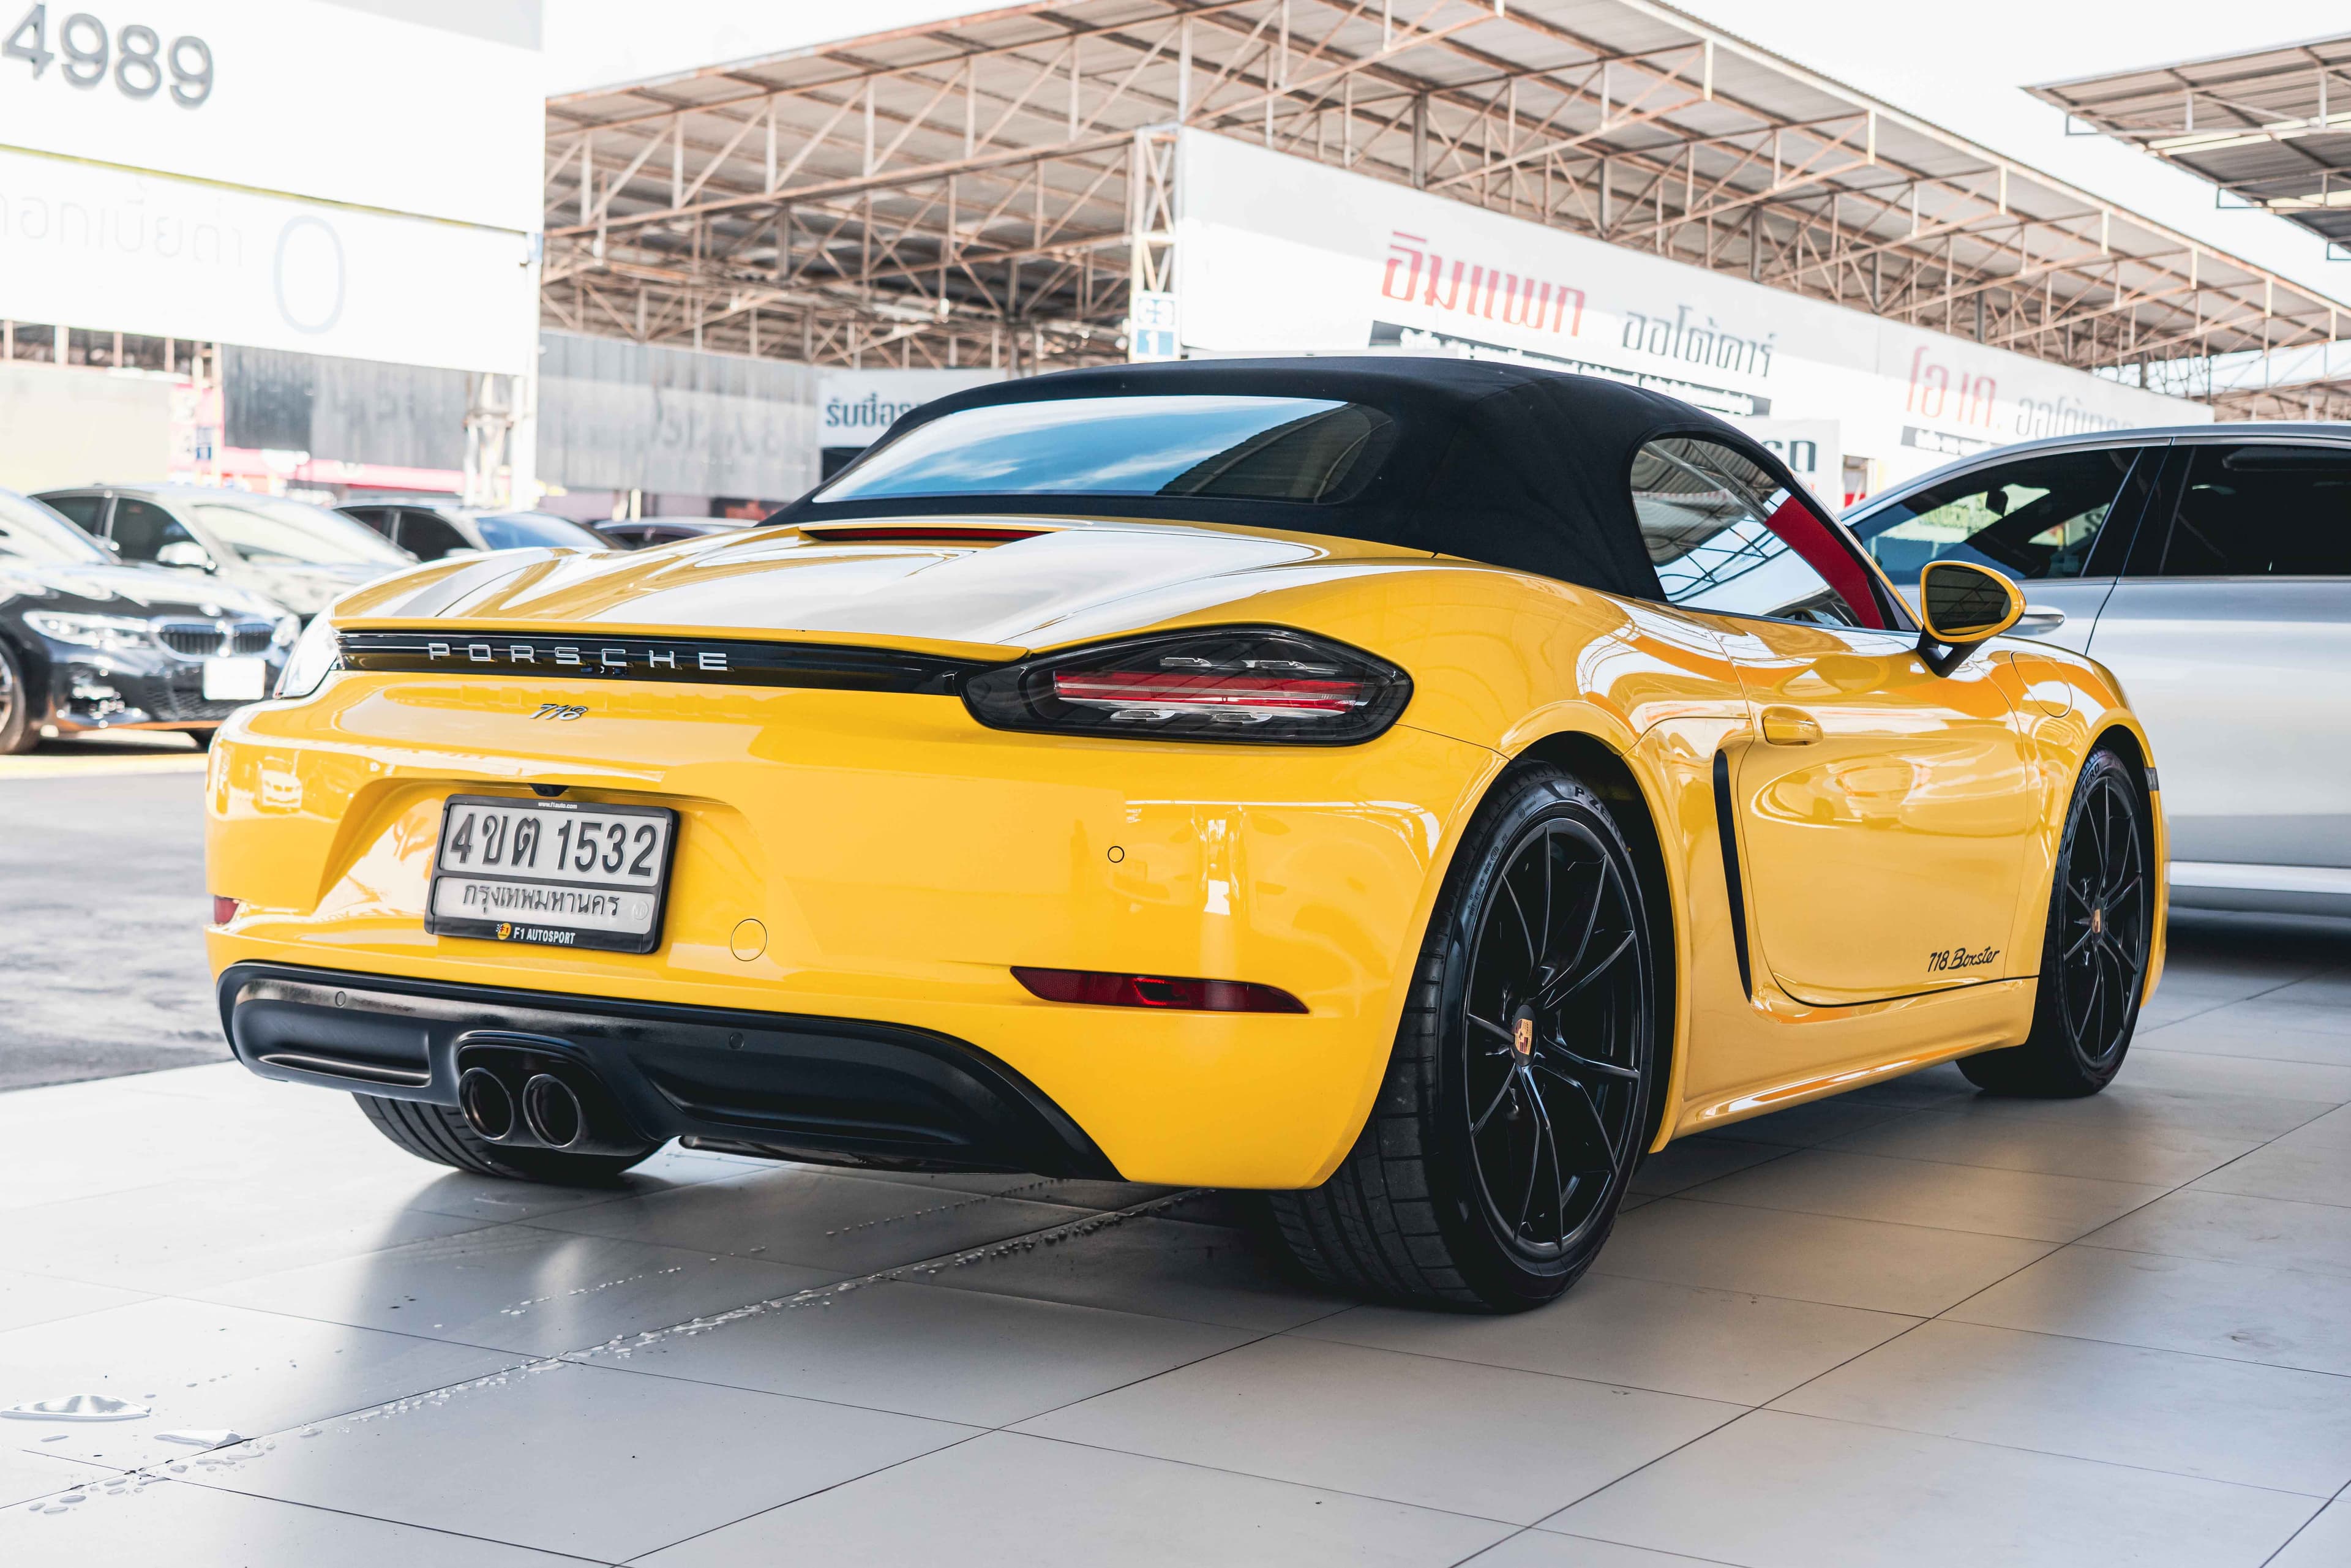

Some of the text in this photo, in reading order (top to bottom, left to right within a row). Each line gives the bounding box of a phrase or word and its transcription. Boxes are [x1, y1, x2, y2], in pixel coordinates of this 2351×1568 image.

[1, 2, 214, 110] 4989
[429, 642, 729, 672] PORSCHE
[529, 703, 588, 721] 718
[557, 819, 658, 877] 1532
[463, 883, 620, 917] กรุงเทพมหานคร
[513, 926, 576, 945] F1 AUTOSPORT
[1927, 946, 2001, 972] 718 Boxster
